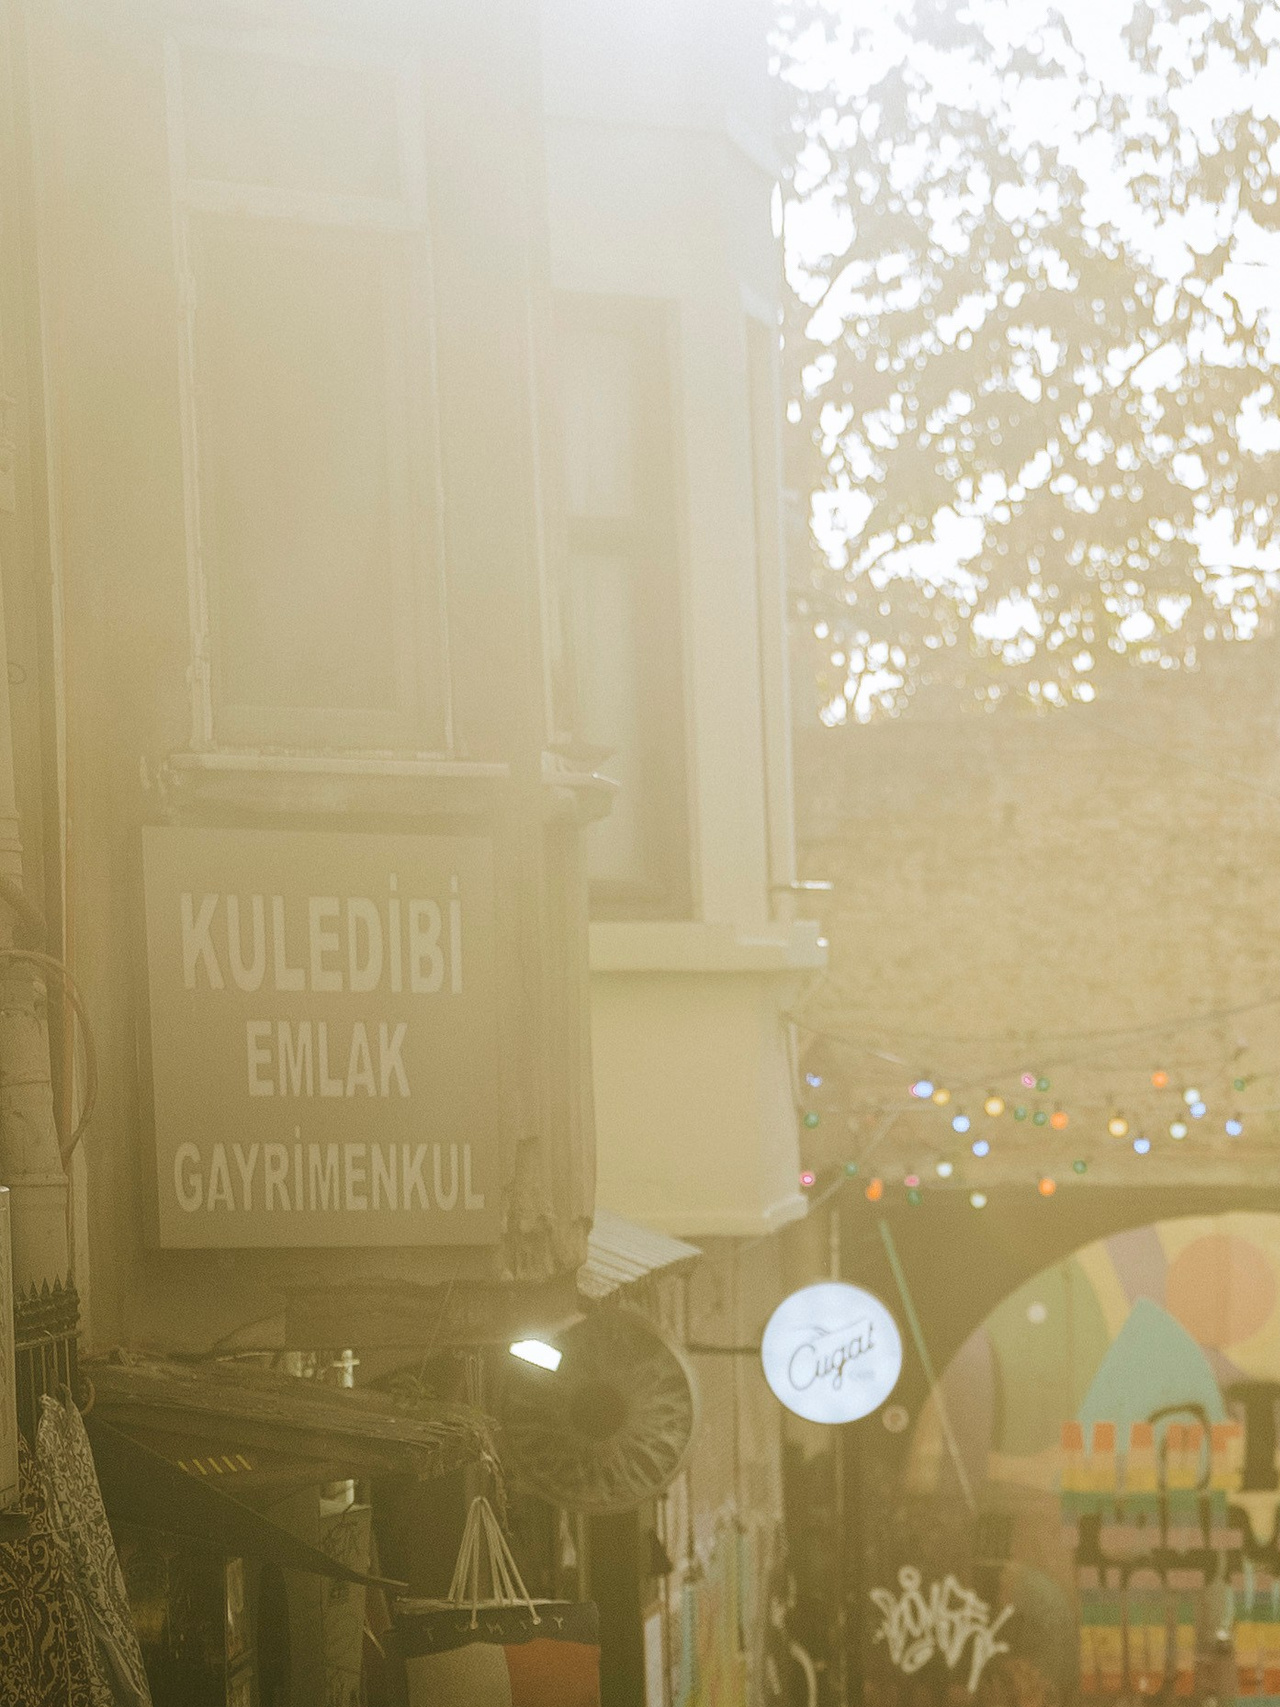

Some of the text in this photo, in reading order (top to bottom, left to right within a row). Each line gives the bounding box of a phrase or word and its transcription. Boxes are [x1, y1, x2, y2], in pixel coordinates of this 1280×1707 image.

[180, 873, 463, 994] KULEDİBİ
[246, 1020, 412, 1098] EMLAK
[174, 1126, 486, 1212] GAYRİMENKUL
